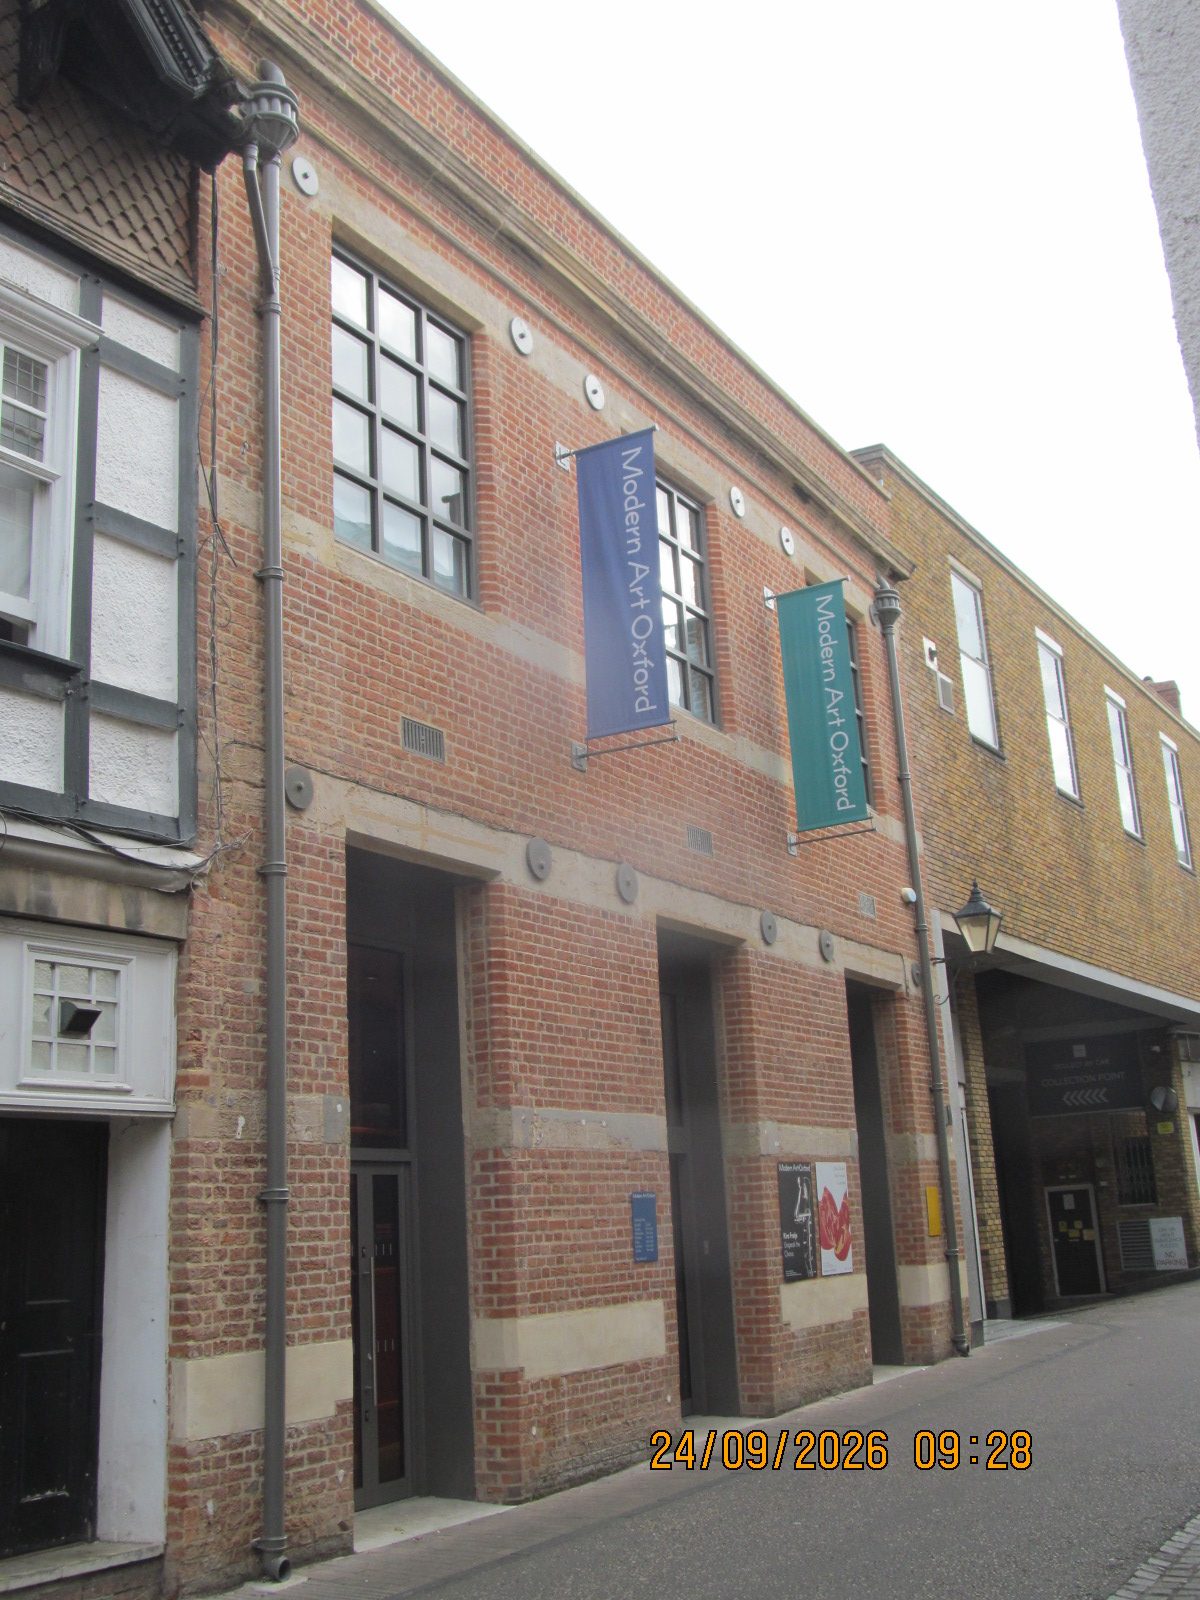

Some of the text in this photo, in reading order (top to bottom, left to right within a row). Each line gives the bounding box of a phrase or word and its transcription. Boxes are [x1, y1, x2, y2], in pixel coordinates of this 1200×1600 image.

[621, 446, 657, 714] Modern Art Oxford
[815, 593, 856, 811] Modern Art Oxford
[1040, 1071, 1126, 1087] COLLECTION POINT
